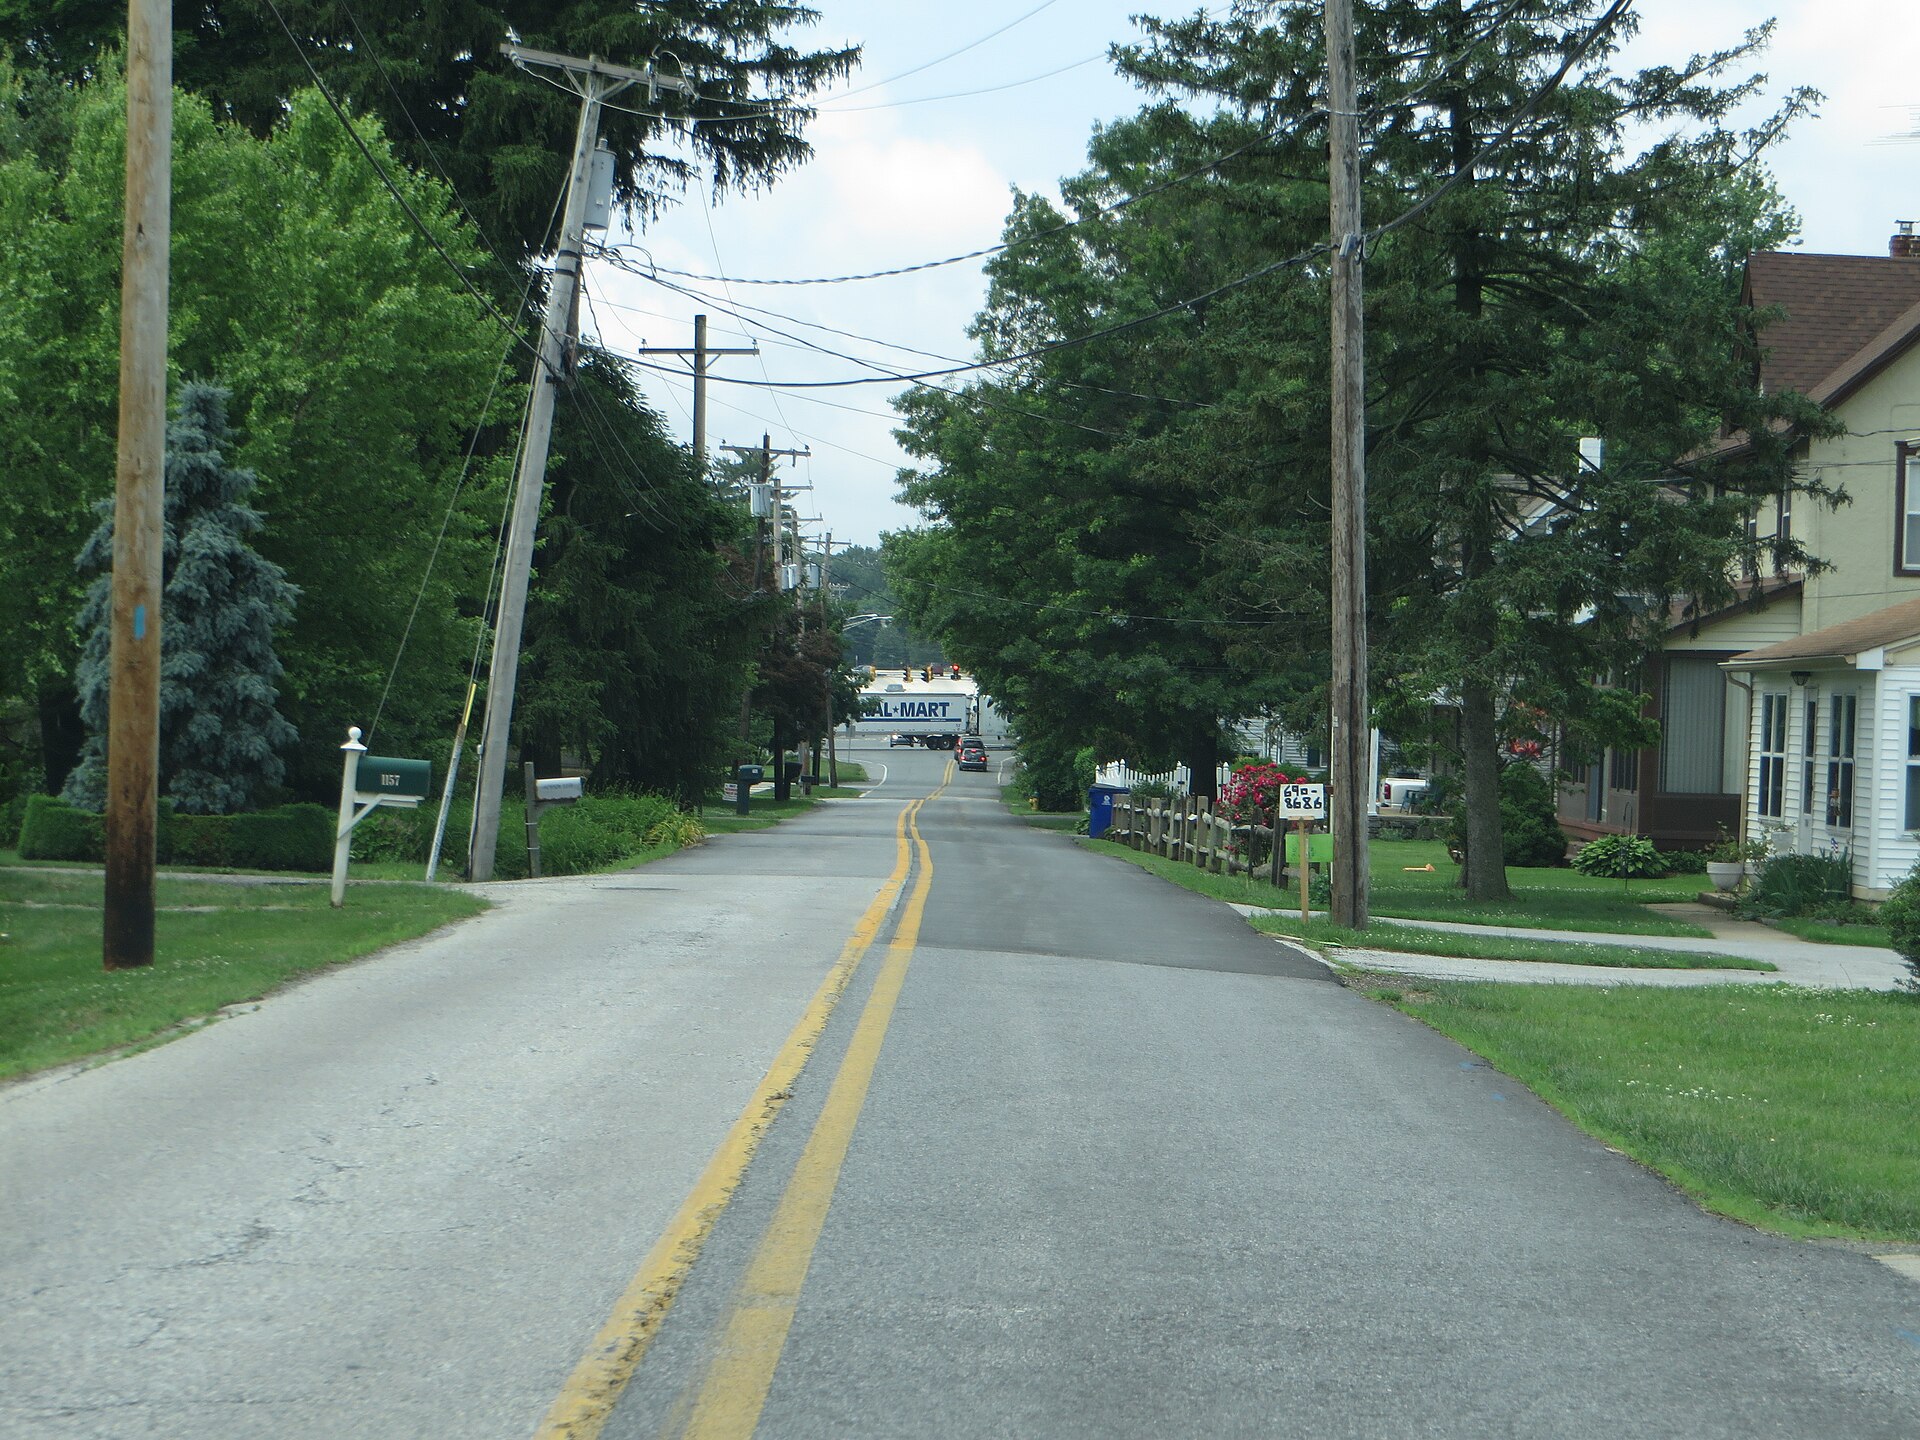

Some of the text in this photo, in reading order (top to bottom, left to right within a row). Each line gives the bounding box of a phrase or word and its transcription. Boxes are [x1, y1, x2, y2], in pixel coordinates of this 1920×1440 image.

[900, 702, 949, 717] MART
[381, 774, 400, 786] 1157
[1284, 785, 1317, 797] 690-
[1284, 797, 1322, 809] 8686
